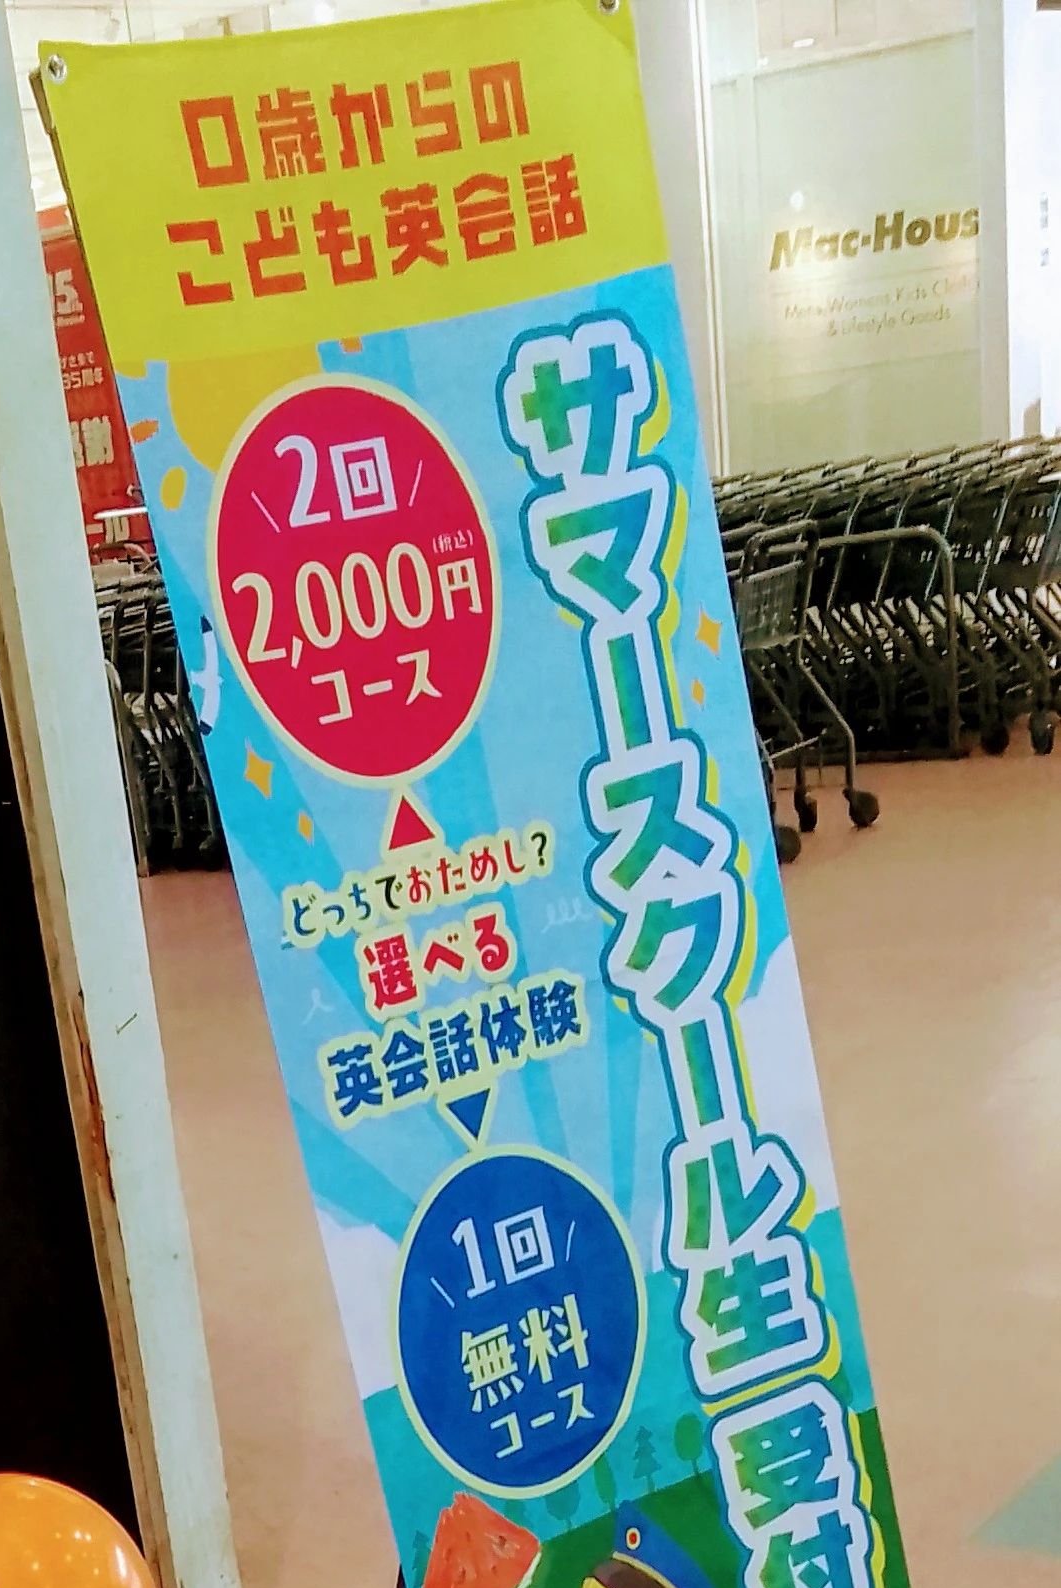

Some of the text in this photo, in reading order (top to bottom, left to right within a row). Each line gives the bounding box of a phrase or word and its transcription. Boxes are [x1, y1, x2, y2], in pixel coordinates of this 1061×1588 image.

[179, 61, 529, 188] 0歳からの
[167, 154, 587, 305] こども英会話
[274, 434, 398, 528] 2回
[232, 542, 483, 669] 2,000円
[310, 649, 442, 726] コース
[290, 831, 551, 937] どっちでおためし?
[519, 344, 807, 1380] サマースクール生
[365, 913, 512, 1011] 選べる
[326, 981, 585, 1118] 英会話体験
[451, 1206, 555, 1300] 1回
[460, 1293, 590, 1413] 無料
[490, 1387, 595, 1460] コース
